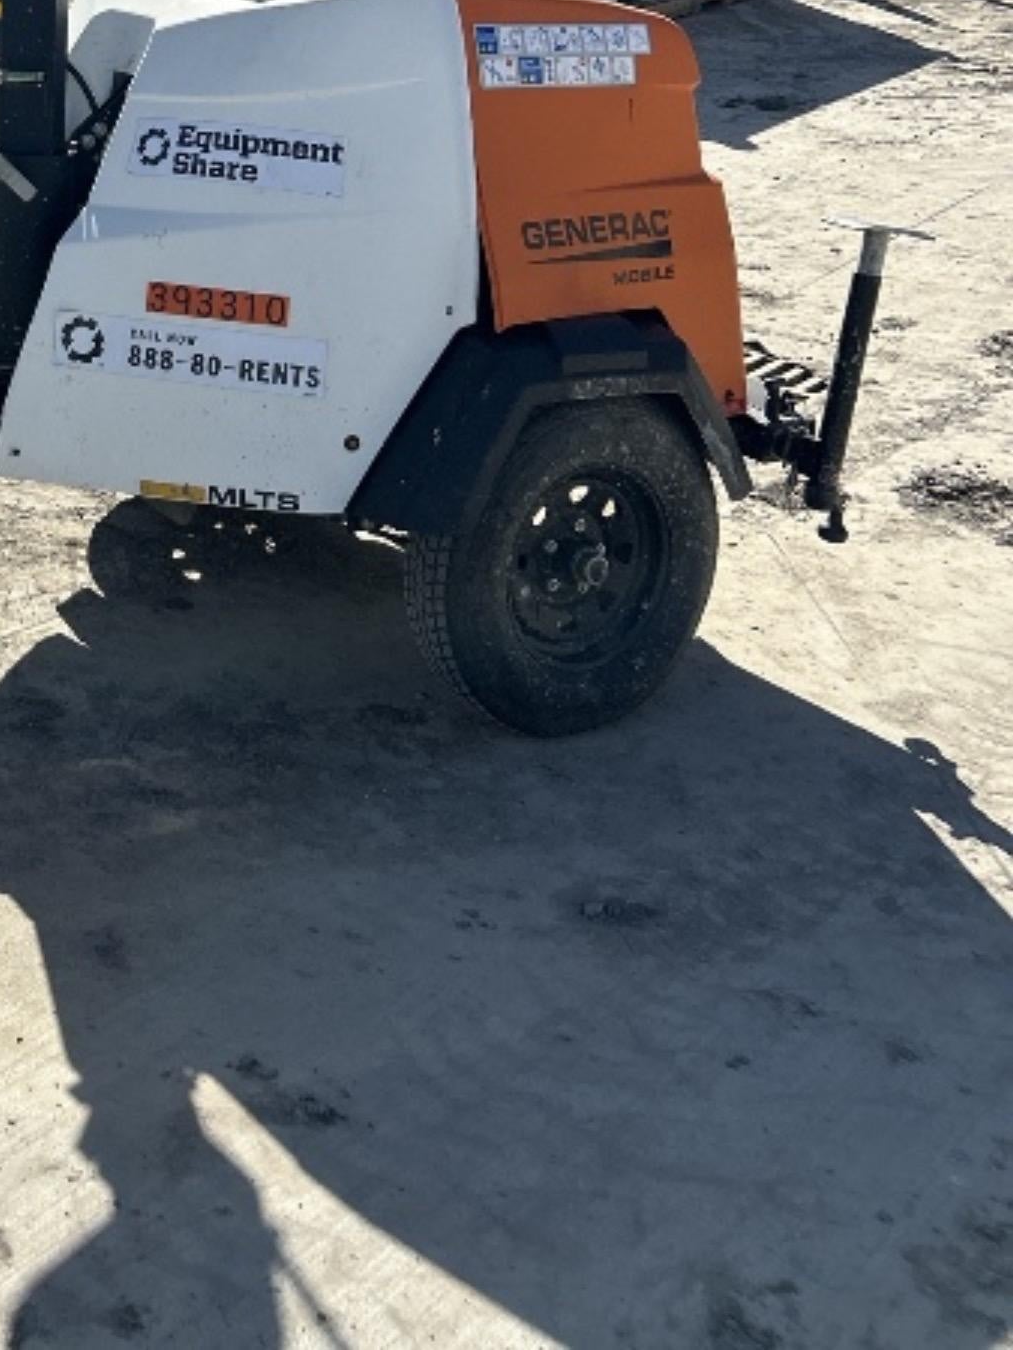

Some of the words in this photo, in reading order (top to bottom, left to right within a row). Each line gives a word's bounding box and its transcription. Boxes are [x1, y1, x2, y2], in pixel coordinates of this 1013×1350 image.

[176, 125, 345, 164] Equipment
[172, 153, 259, 183] Share
[521, 209, 672, 250] GENERAC
[148, 282, 287, 325] 393310
[128, 345, 321, 388] 888-80-RENTS
